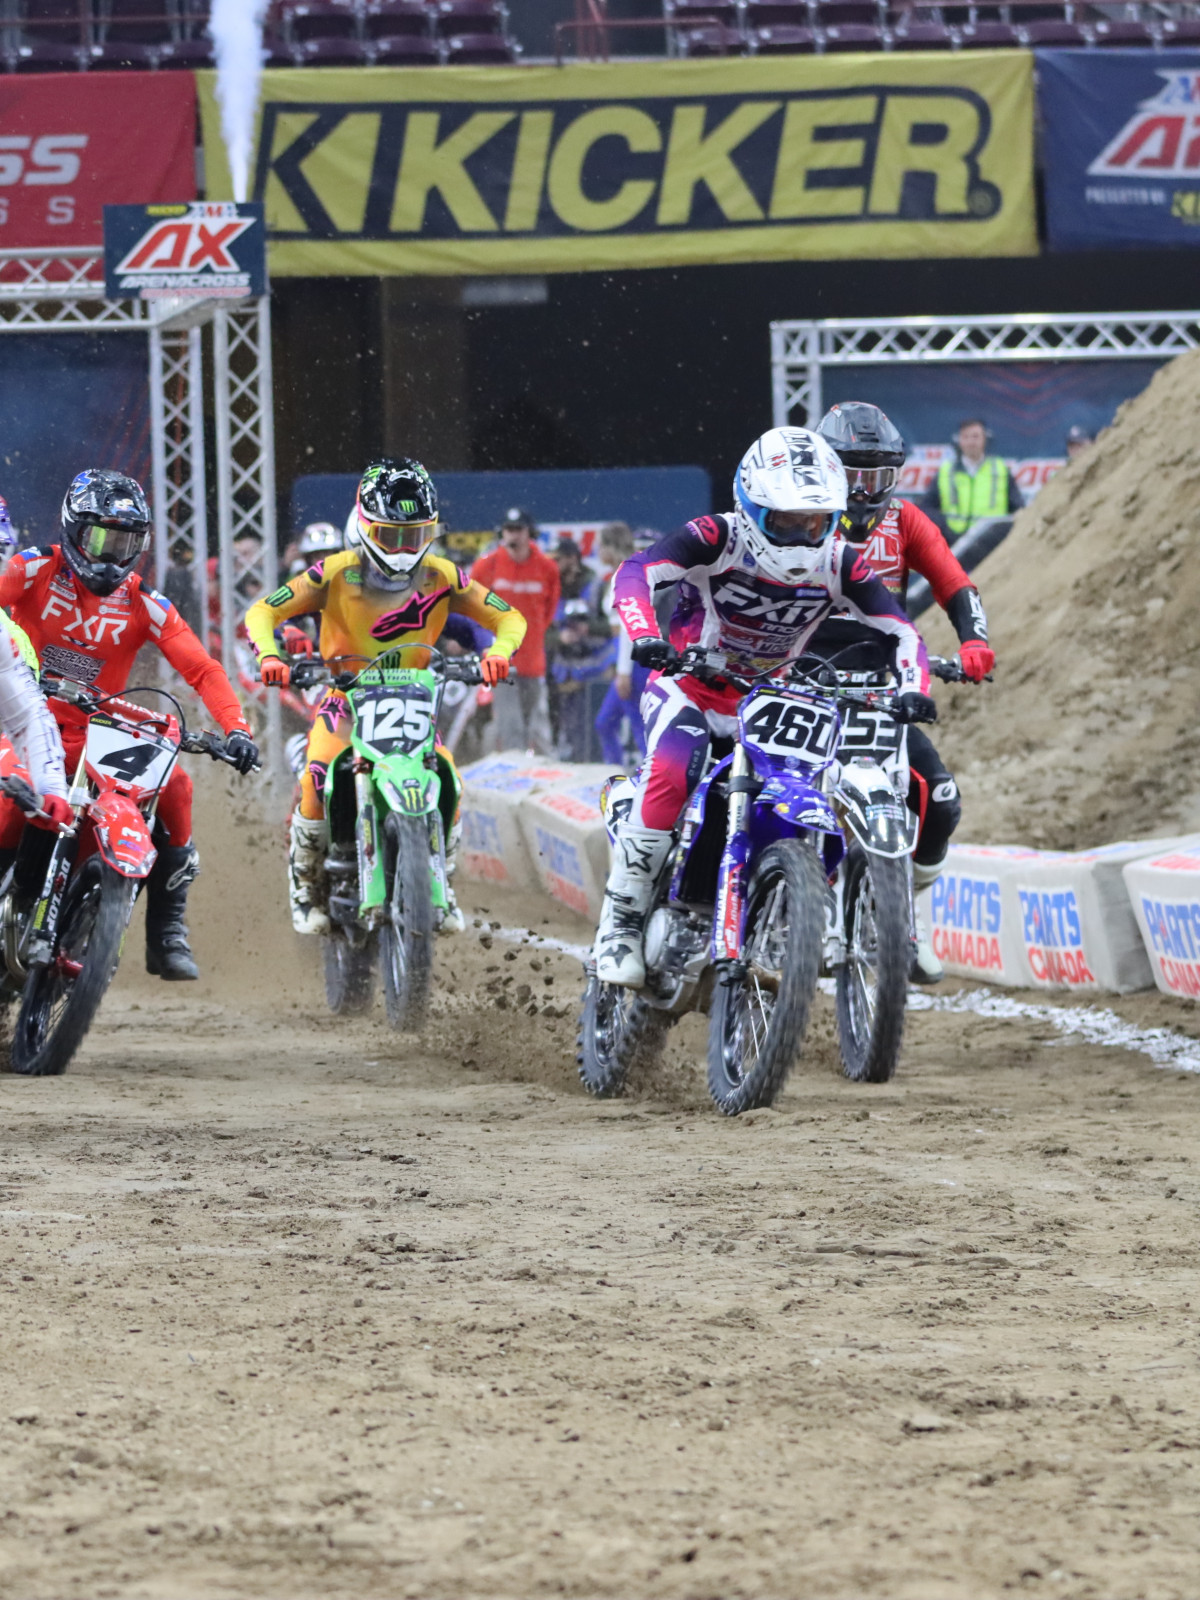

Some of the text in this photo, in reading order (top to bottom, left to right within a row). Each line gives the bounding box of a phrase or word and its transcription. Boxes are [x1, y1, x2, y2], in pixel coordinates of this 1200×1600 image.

[125, 223, 245, 269] AX
[118, 274, 251, 289] ARENACROSS
[40, 594, 129, 646] FXR
[712, 581, 827, 625] FXR
[357, 698, 433, 743] 125
[97, 743, 164, 783] 4
[931, 875, 1001, 934] PARTS
[1018, 890, 1082, 947] PARTS
[931, 927, 1004, 971] CANADA
